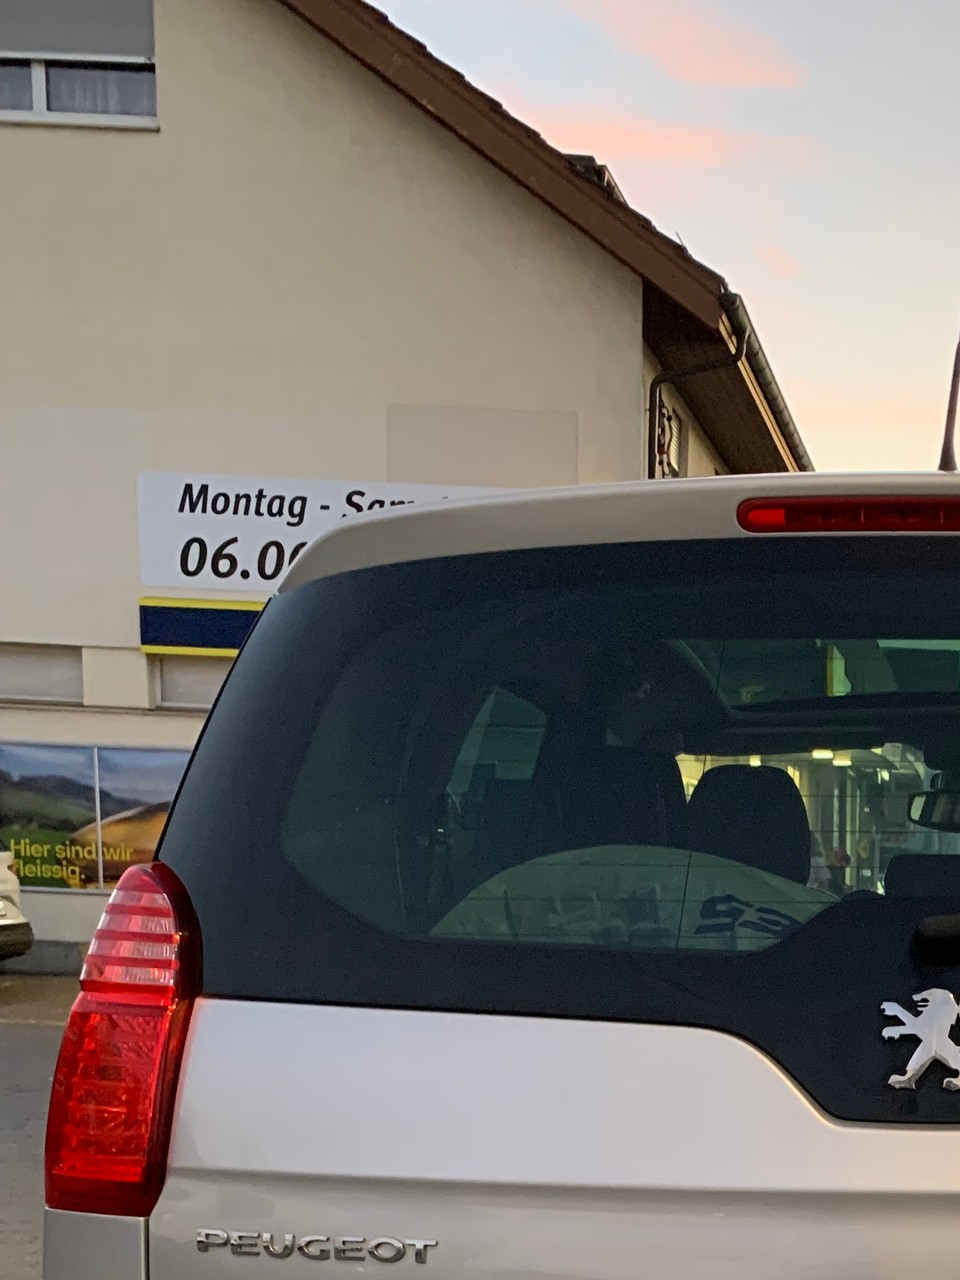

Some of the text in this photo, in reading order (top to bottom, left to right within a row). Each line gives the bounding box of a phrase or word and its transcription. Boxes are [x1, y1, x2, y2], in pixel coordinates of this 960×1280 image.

[178, 483, 307, 527] Montag
[10, 838, 134, 860] Hier sind wir
[196, 1228, 439, 1264] PEUGEOT
